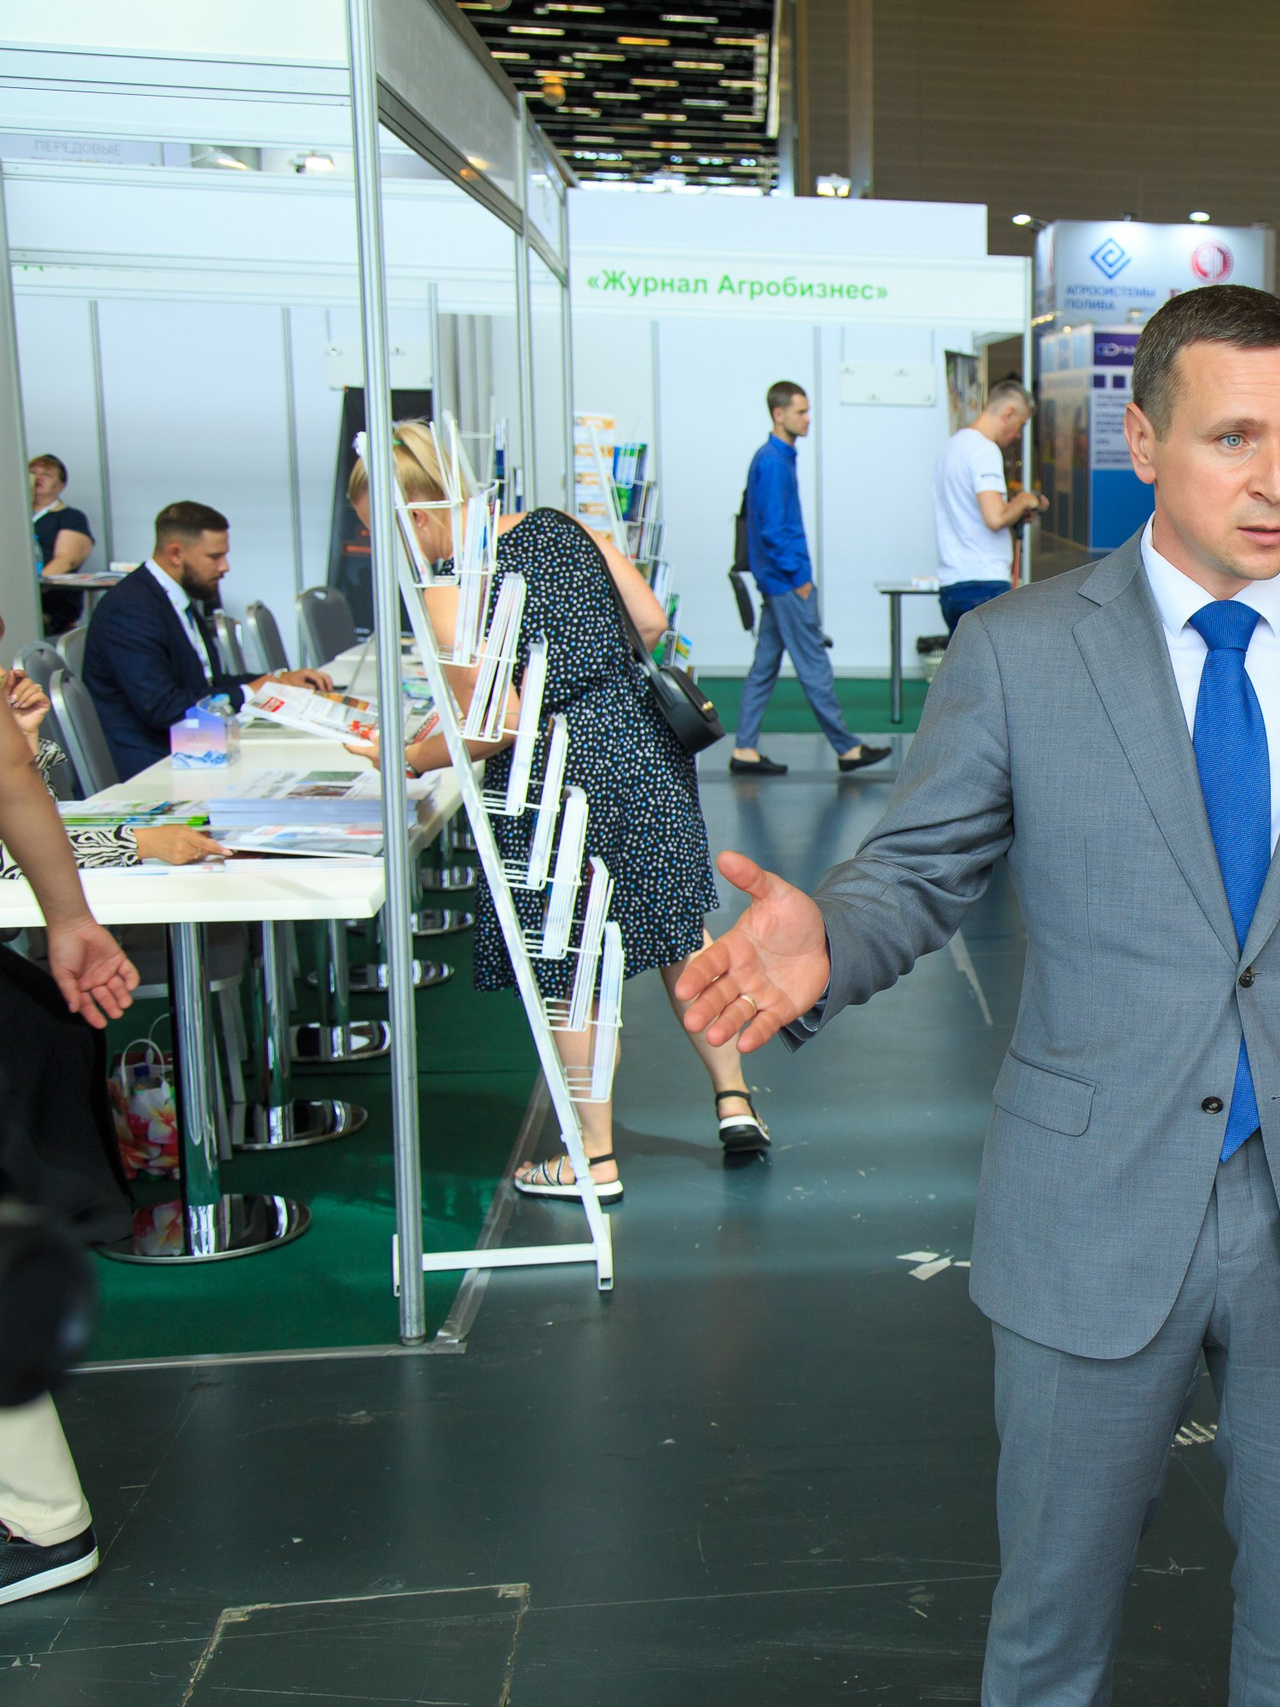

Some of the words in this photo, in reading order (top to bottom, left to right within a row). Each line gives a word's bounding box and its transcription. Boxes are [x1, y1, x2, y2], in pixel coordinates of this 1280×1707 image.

[34, 139, 122, 156] ПЕРЕДОВЫЕ
[587, 269, 708, 298] «Журнал
[717, 274, 888, 301] Агробизнес»
[1066, 284, 1156, 298] АГРОСИСТЕМЫ
[1064, 298, 1117, 311] ПОЛИВА
